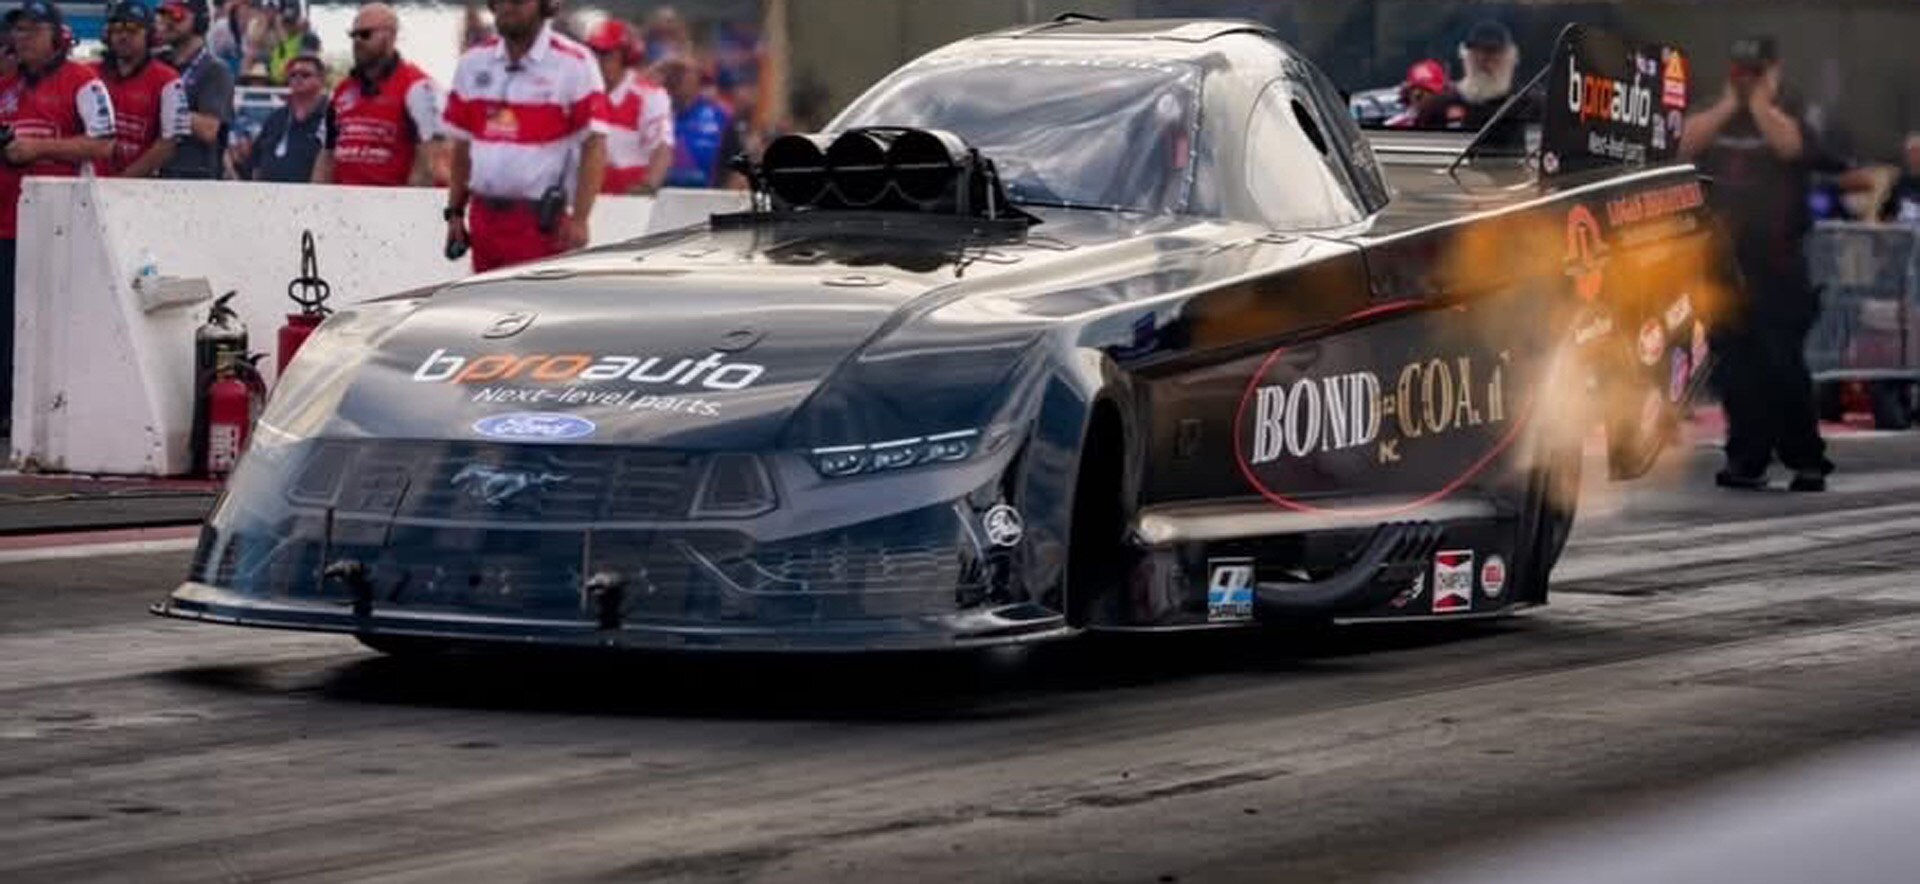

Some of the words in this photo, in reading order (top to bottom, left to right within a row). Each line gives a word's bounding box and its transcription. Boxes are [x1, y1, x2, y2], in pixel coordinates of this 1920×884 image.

[1568, 54, 1651, 127] bproauto
[413, 348, 765, 390] bproauto
[472, 386, 634, 408] Next-level
[630, 394, 723, 418] parts.
[1251, 371, 1381, 465] BOND
